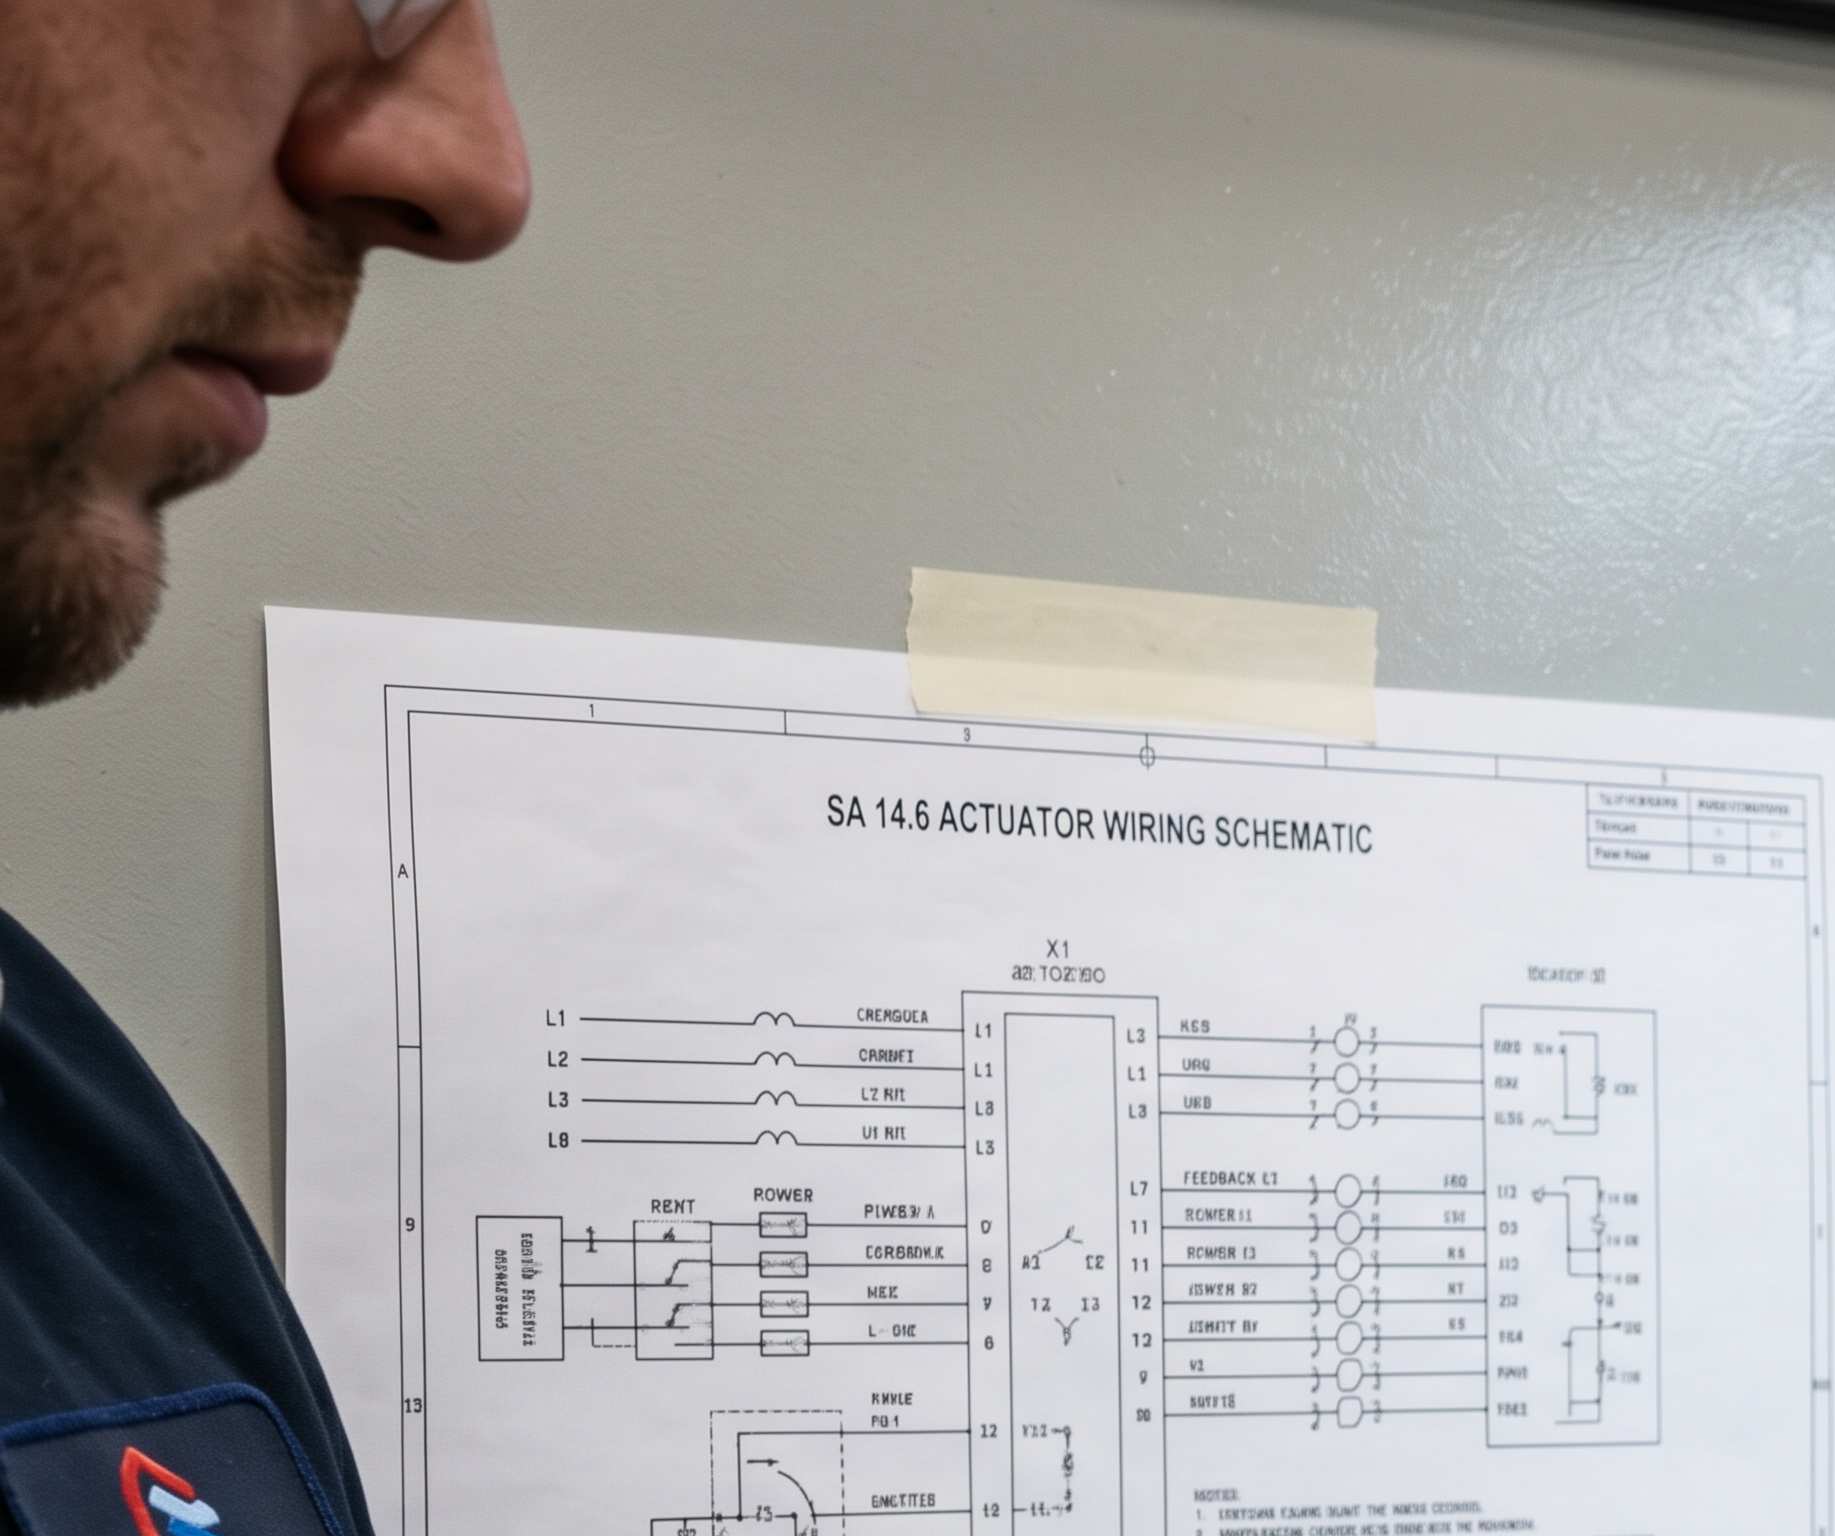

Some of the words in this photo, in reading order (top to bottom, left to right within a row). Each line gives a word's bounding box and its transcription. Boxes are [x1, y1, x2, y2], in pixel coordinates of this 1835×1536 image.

[826, 793, 866, 829] SA
[875, 796, 931, 832] 14.6
[938, 801, 1096, 841] ACTUATOR
[1103, 808, 1206, 845] WIRING
[1214, 815, 1374, 854] SCHEMATIC
[1046, 939, 1071, 960] X1
[545, 1009, 566, 1027] L1
[975, 1022, 993, 1039] L1
[1127, 1028, 1146, 1044] L3
[547, 1050, 570, 1068] L2
[974, 1061, 993, 1078] L1
[1127, 1066, 1147, 1082] L1
[547, 1091, 571, 1109] L3
[975, 1139, 996, 1156] L3
[1130, 1181, 1149, 1197] L7
